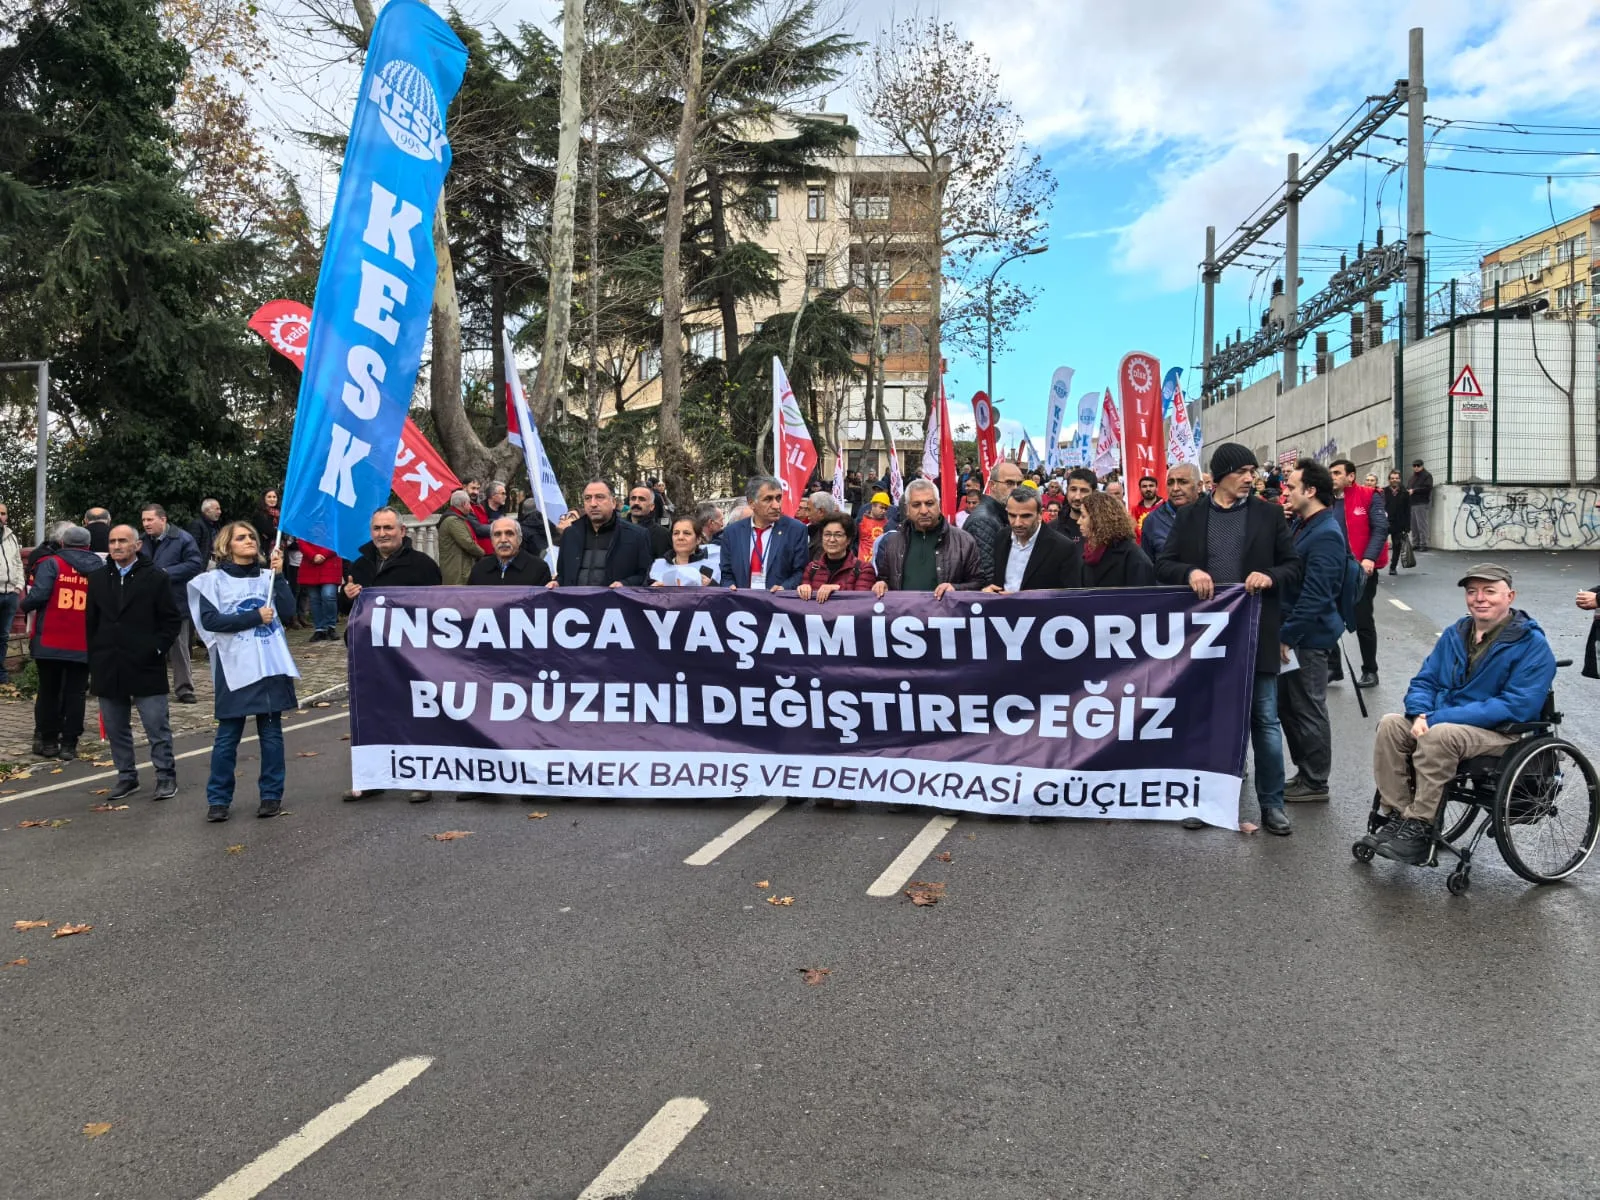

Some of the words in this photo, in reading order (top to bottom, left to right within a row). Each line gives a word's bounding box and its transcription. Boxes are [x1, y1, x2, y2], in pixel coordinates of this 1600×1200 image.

[369, 74, 449, 164] KESK
[395, 131, 421, 154] 1995
[318, 180, 423, 509] KESK
[371, 595, 635, 649] İNSANCA
[643, 610, 857, 670] YAŞAM
[872, 602, 1230, 661] İSTİYORUZ
[410, 680, 478, 721] BU
[489, 670, 689, 723] DÜZENİ
[702, 675, 1176, 743] DEĞİŞTİRECEĞİZ
[391, 750, 537, 785] İSTANBUL
[547, 761, 640, 787] EMEK
[650, 762, 749, 793] BARIŞ
[760, 764, 802, 788] VE
[812, 766, 1022, 804] DEMOKRASİ
[1033, 776, 1200, 814] GÜÇLERİ
